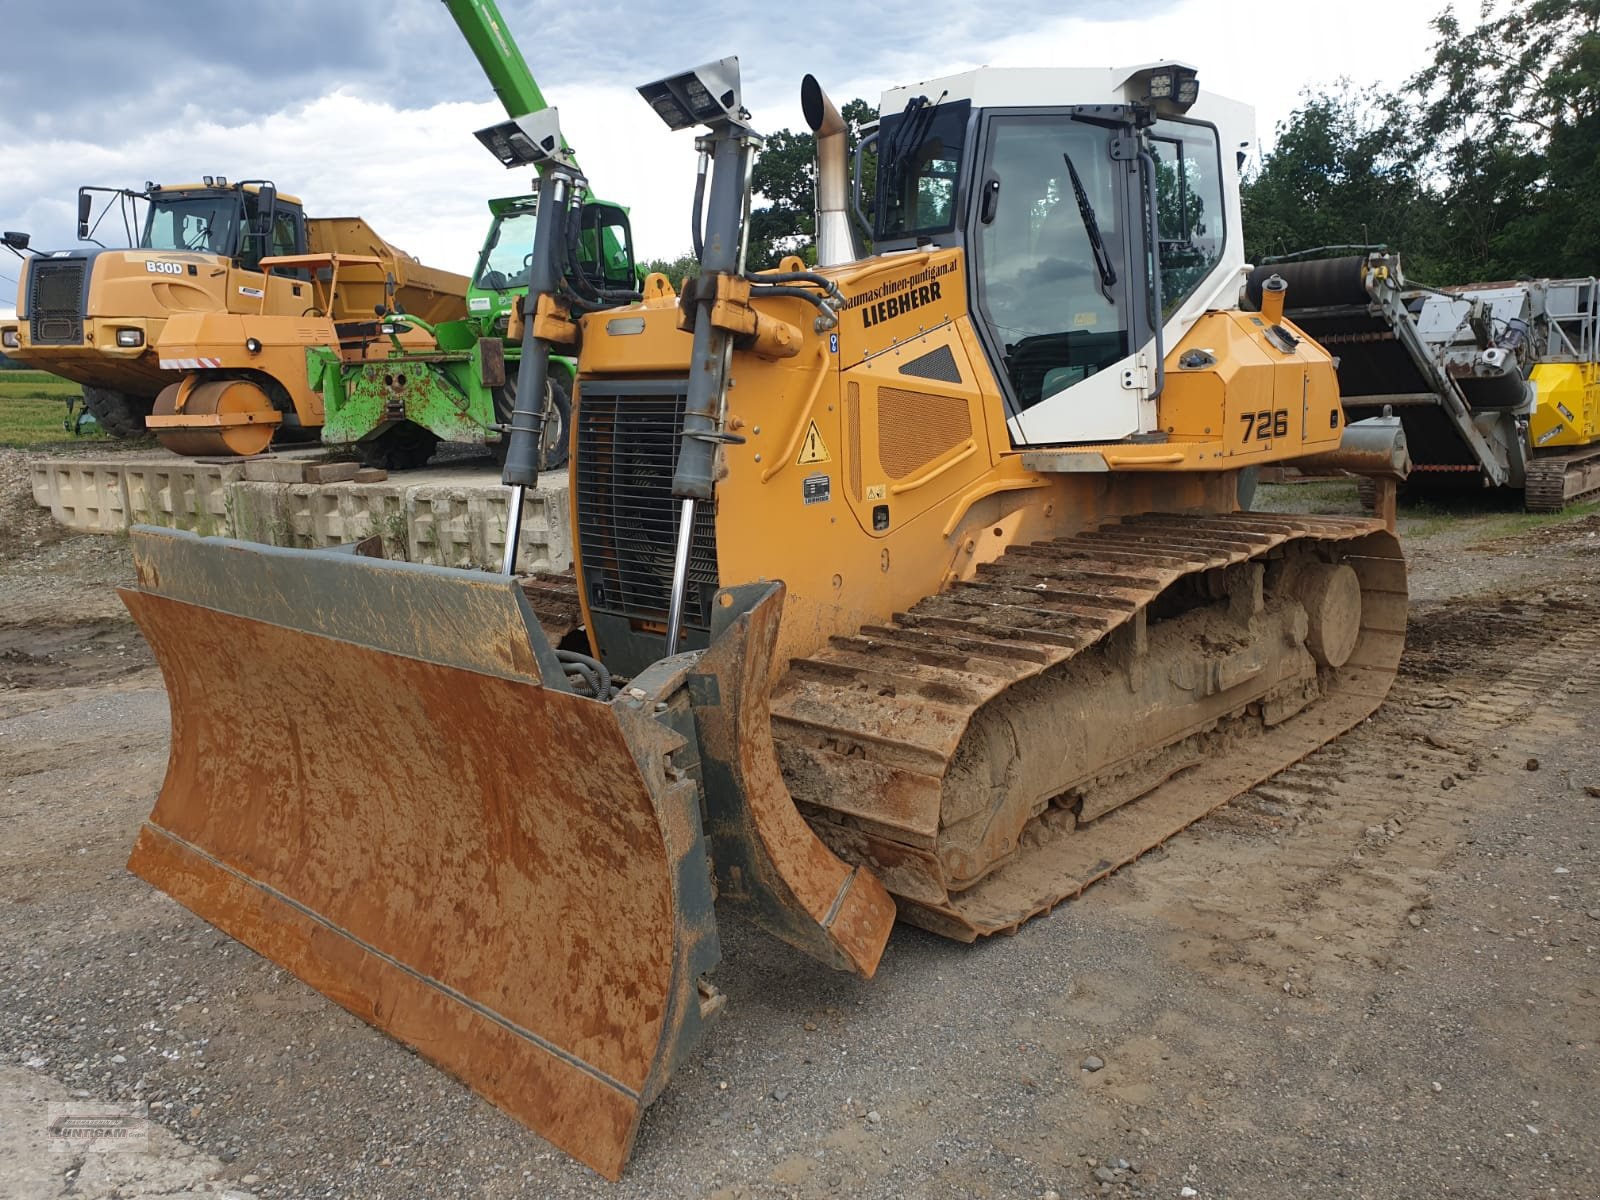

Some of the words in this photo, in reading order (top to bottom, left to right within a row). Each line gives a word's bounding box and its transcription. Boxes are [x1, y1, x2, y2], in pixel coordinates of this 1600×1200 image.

[146, 261, 183, 274] B30D
[862, 281, 942, 328] LIEBHERR
[1240, 409, 1289, 443] 726
